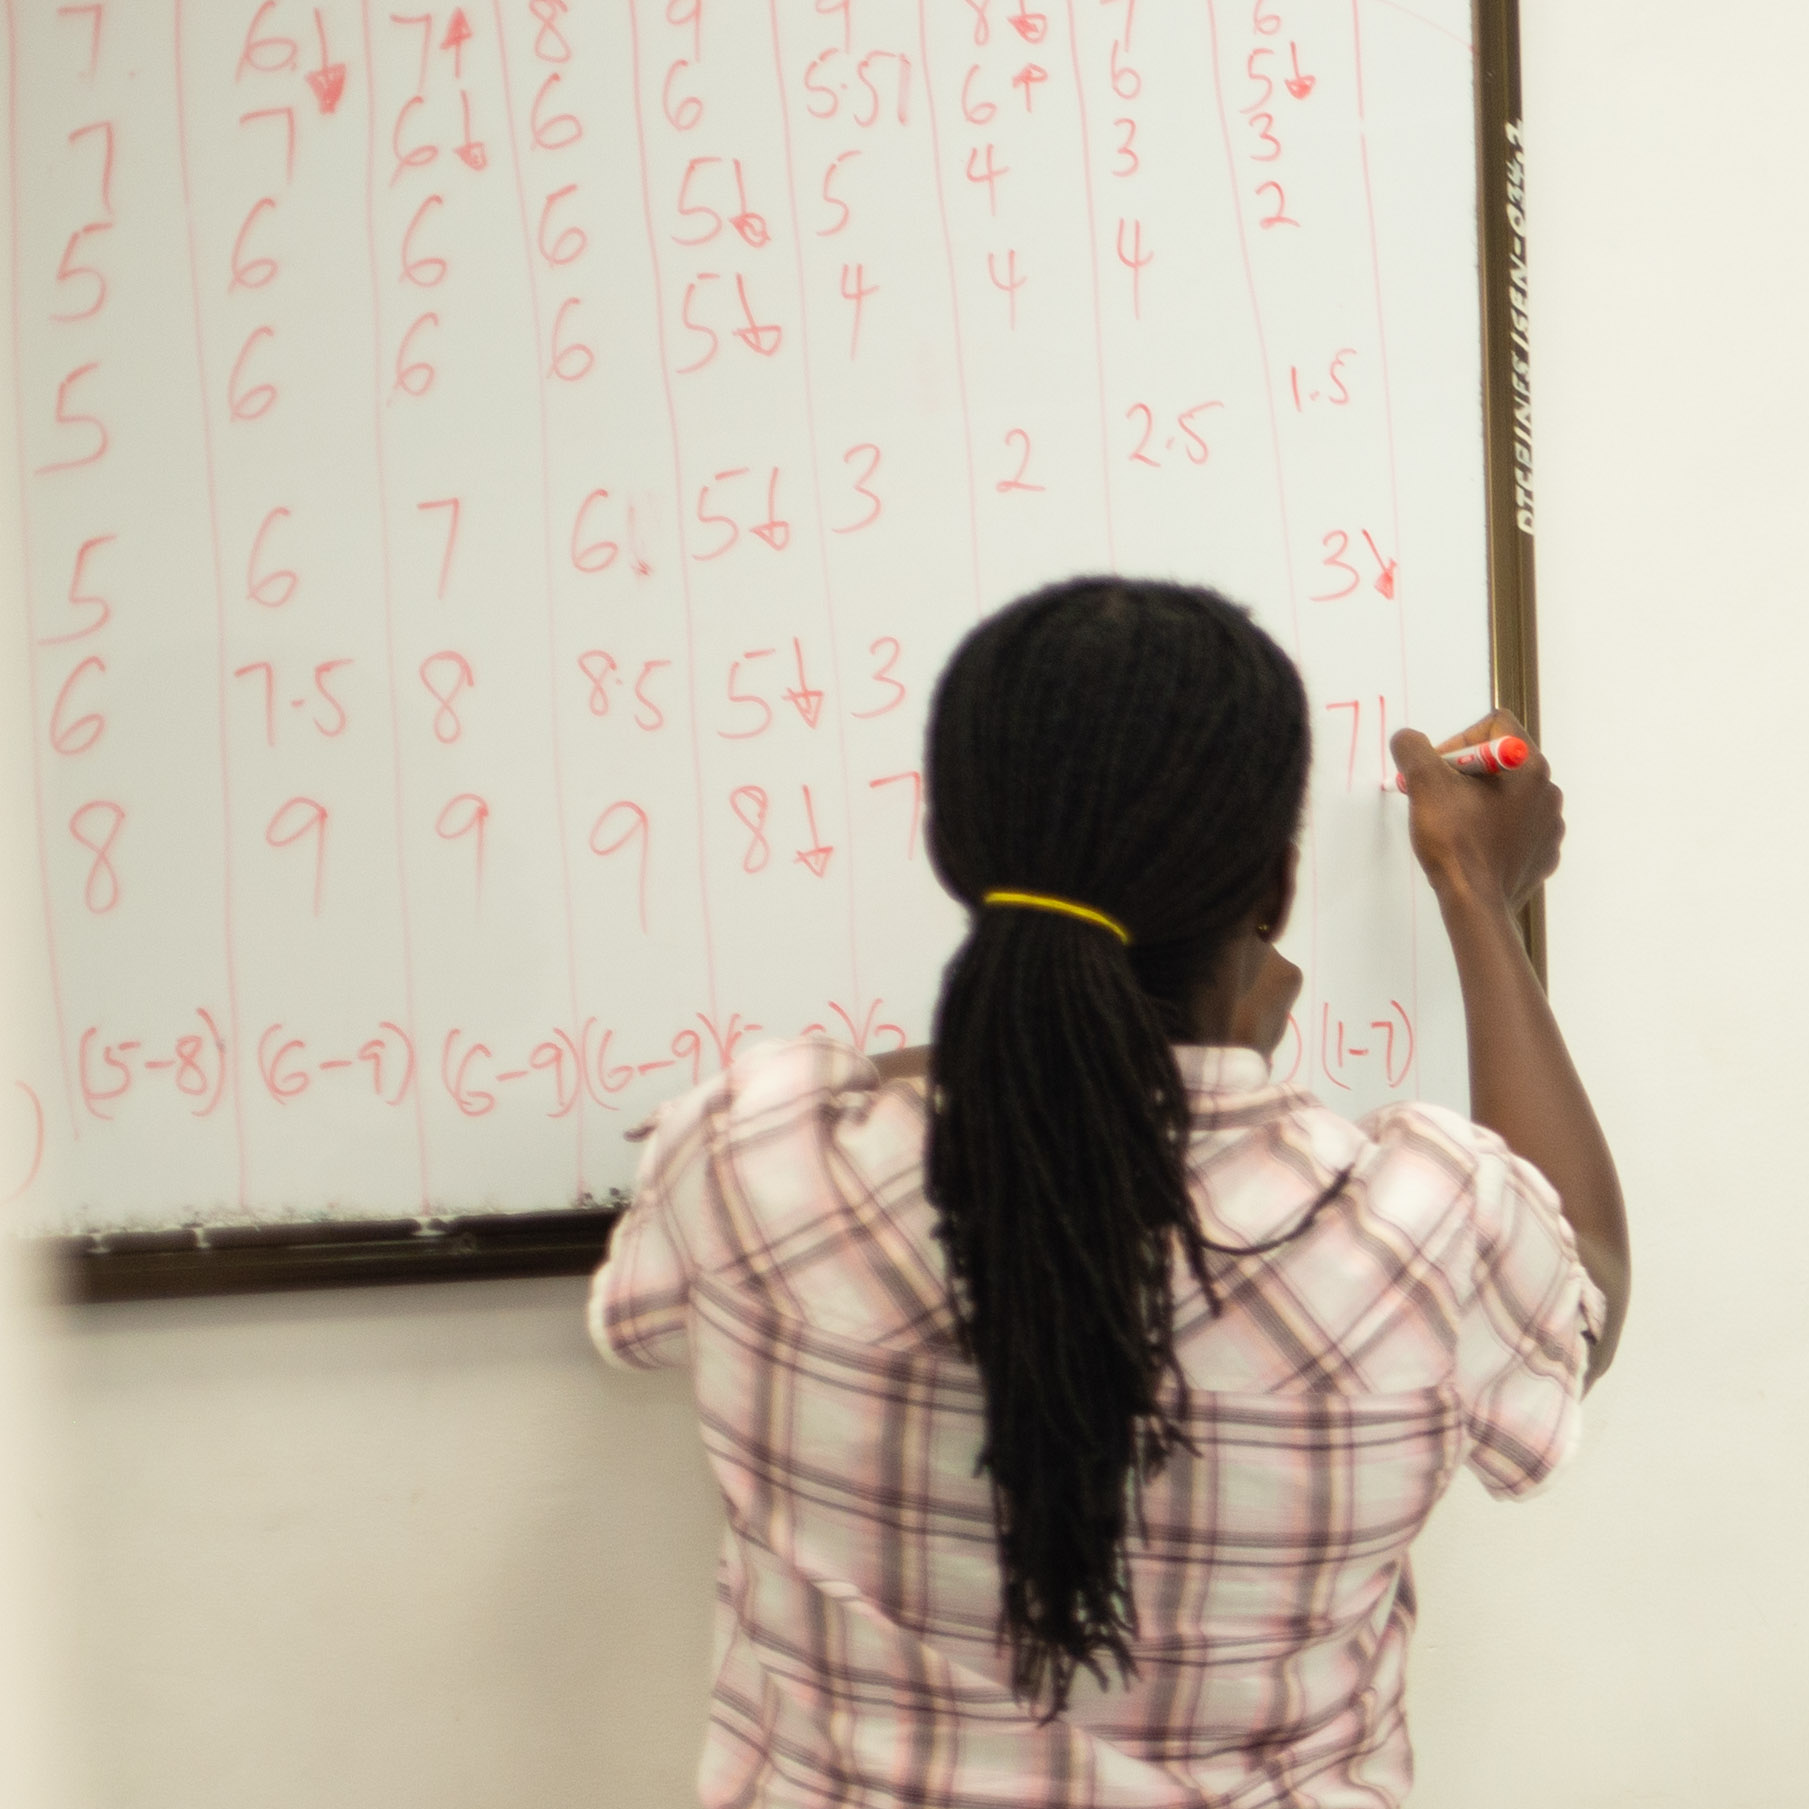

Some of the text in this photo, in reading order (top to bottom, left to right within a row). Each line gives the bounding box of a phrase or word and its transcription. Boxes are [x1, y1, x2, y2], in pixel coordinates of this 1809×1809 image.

[57, 2, 102, 82] 7
[234, 0, 298, 83] 6
[389, 13, 432, 96] 7
[529, 0, 572, 63] 8
[68, 120, 115, 213] 7
[239, 107, 295, 185] 7
[390, 96, 439, 188] 6
[531, 73, 583, 152] 6
[662, 59, 704, 131] 6
[961, 63, 997, 125] 6
[1110, 39, 1142, 99] 6
[1238, 48, 1275, 114] 5
[49, 112, 1283, 323] 5 6 6 6 5 5 4 3 3
[34, 181, 1301, 475] 5 6 6 6 5 4 4 4 2
[37, 534, 117, 647] 5
[246, 507, 298, 607] 6
[417, 498, 461, 600] 7
[571, 488, 619, 573] 6
[691, 467, 750, 561] 5
[831, 443, 882, 534] 3
[996, 428, 1046, 493] 2
[49, 656, 107, 755] 6
[234, 658, 356, 747] 7.5
[418, 650, 474, 744] 8
[716, 648, 778, 740] 5
[851, 636, 906, 720] 3
[1309, 529, 1360, 601] 3
[69, 800, 125, 914] 8
[266, 796, 329, 917] 9
[434, 793, 489, 905] 9
[588, 800, 649, 935] 9
[729, 785, 770, 874] 8
[869, 771, 921, 860] 7
